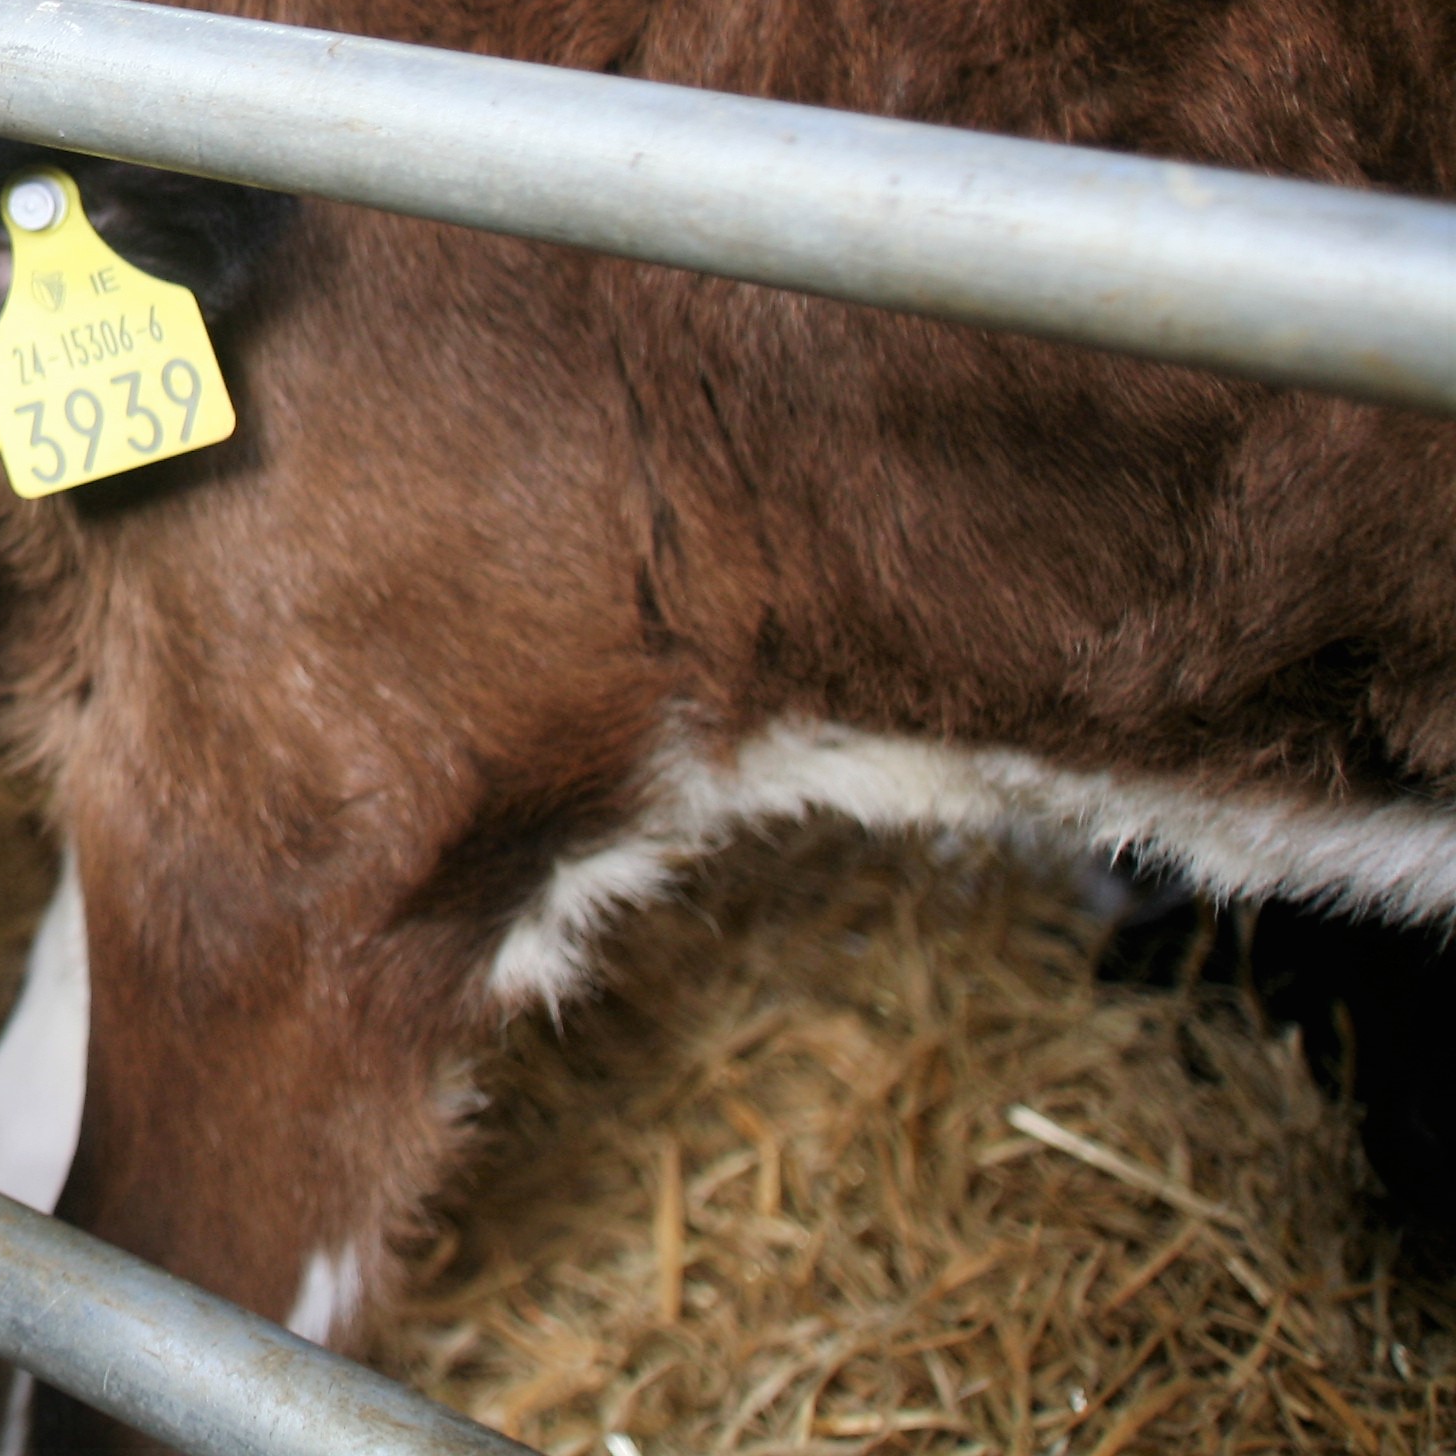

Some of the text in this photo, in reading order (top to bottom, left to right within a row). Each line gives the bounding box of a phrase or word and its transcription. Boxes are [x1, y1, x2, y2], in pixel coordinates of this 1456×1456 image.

[89, 268, 121, 296] IE
[12, 305, 164, 385] 24-15306-6
[14, 358, 202, 483] 3939
